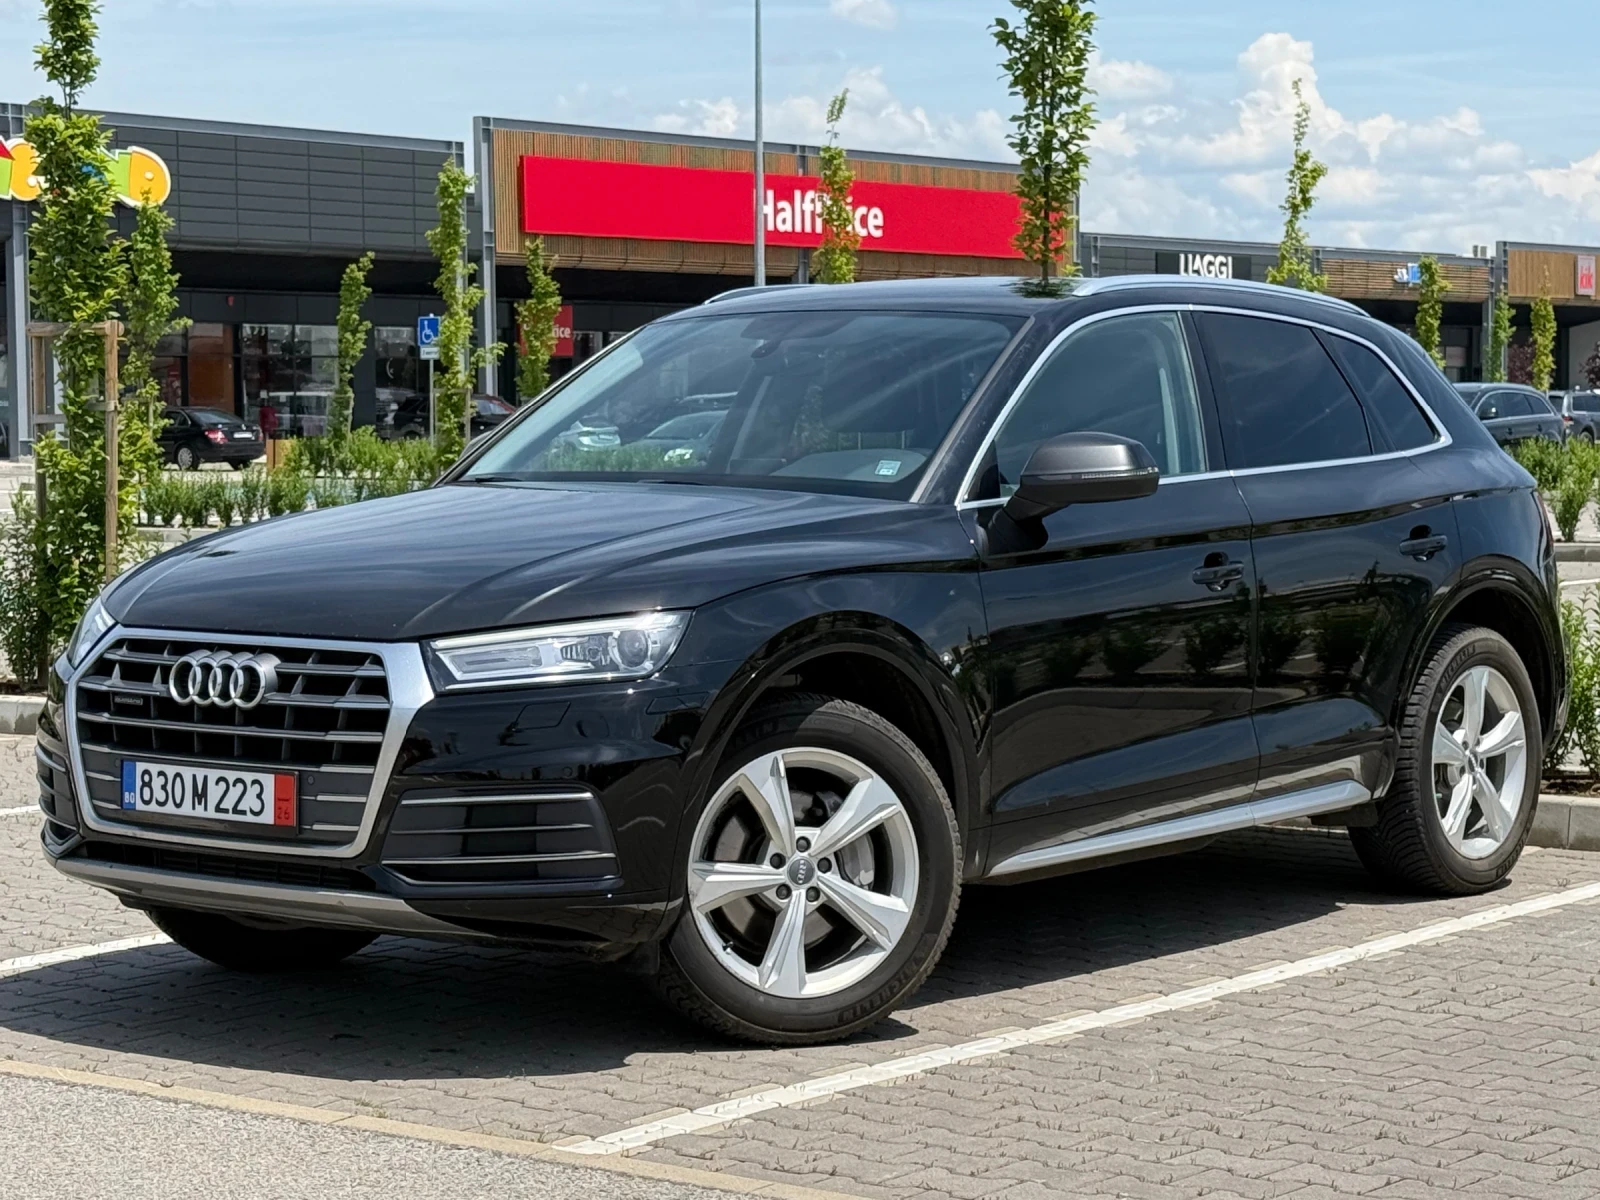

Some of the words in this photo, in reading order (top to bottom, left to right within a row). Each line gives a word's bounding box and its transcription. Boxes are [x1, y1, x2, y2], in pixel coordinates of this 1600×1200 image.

[139, 768, 186, 809] 830
[191, 773, 209, 812] M
[214, 775, 266, 817] 223
[277, 806, 290, 821] 26
